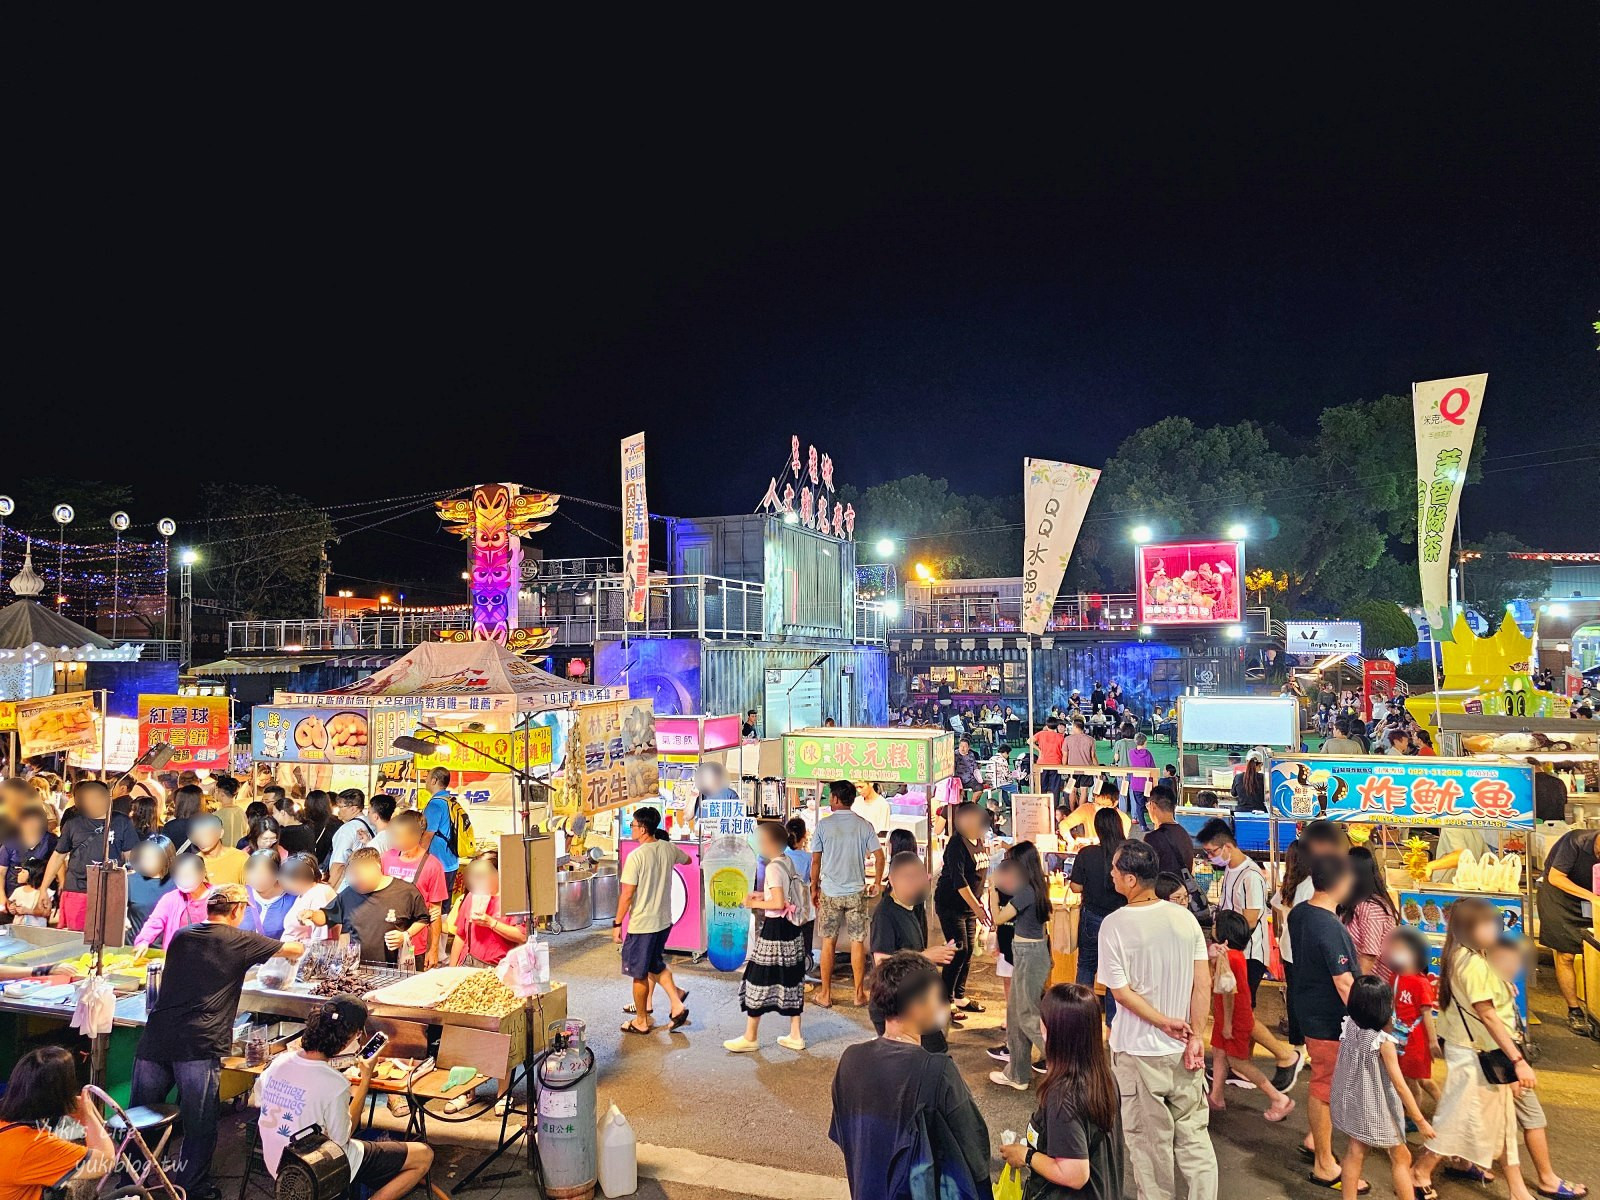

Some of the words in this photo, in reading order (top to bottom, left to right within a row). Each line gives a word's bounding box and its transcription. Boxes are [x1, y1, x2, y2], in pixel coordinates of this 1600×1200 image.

[149, 707, 209, 725] 紅薯球
[834, 742, 911, 769] 狀元糕
[587, 772, 628, 810] 花生
[1357, 776, 1520, 817] 炸魷魚
[709, 801, 745, 818] 藍朋友
[720, 818, 754, 835] 氣泡飲
